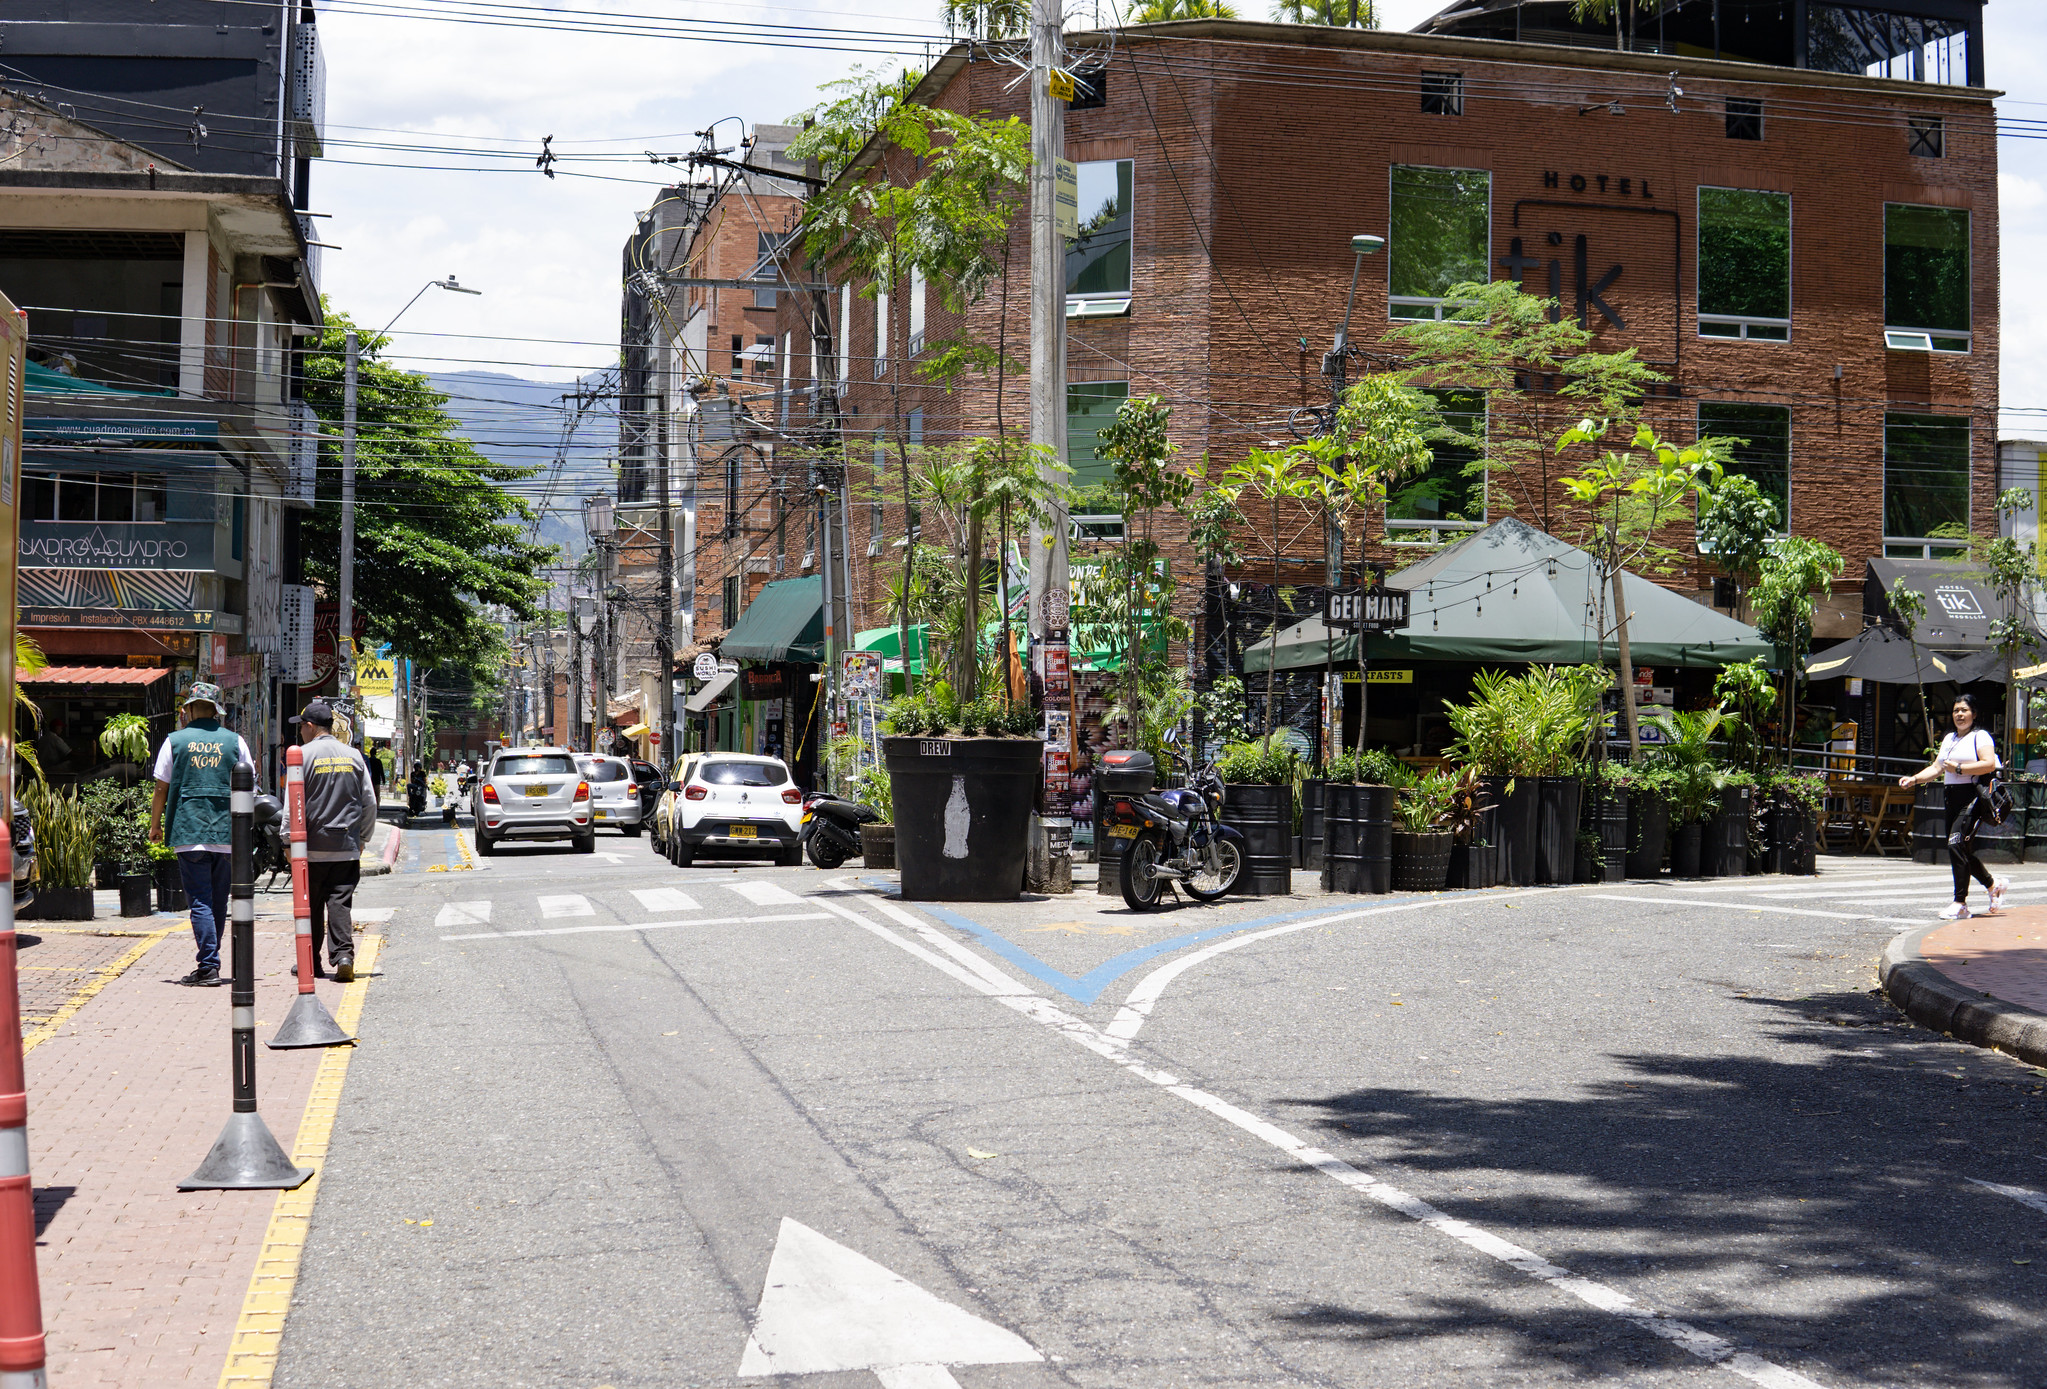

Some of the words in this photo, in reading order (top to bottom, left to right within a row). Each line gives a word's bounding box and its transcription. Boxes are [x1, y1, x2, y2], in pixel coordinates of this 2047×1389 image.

[1544, 171, 1654, 199] HOTEL
[1500, 231, 1626, 332] tik
[1936, 593, 1972, 610] tik
[30, 612, 70, 623] Impresión
[80, 613, 124, 625] Instalación
[132, 615, 149, 626] PBX
[149, 616, 185, 626] 4448612
[1339, 672, 1404, 680] REAKFASTS
[187, 741, 223, 755] BOOK
[921, 742, 950, 755] DREW
[191, 755, 222, 770] NOW
